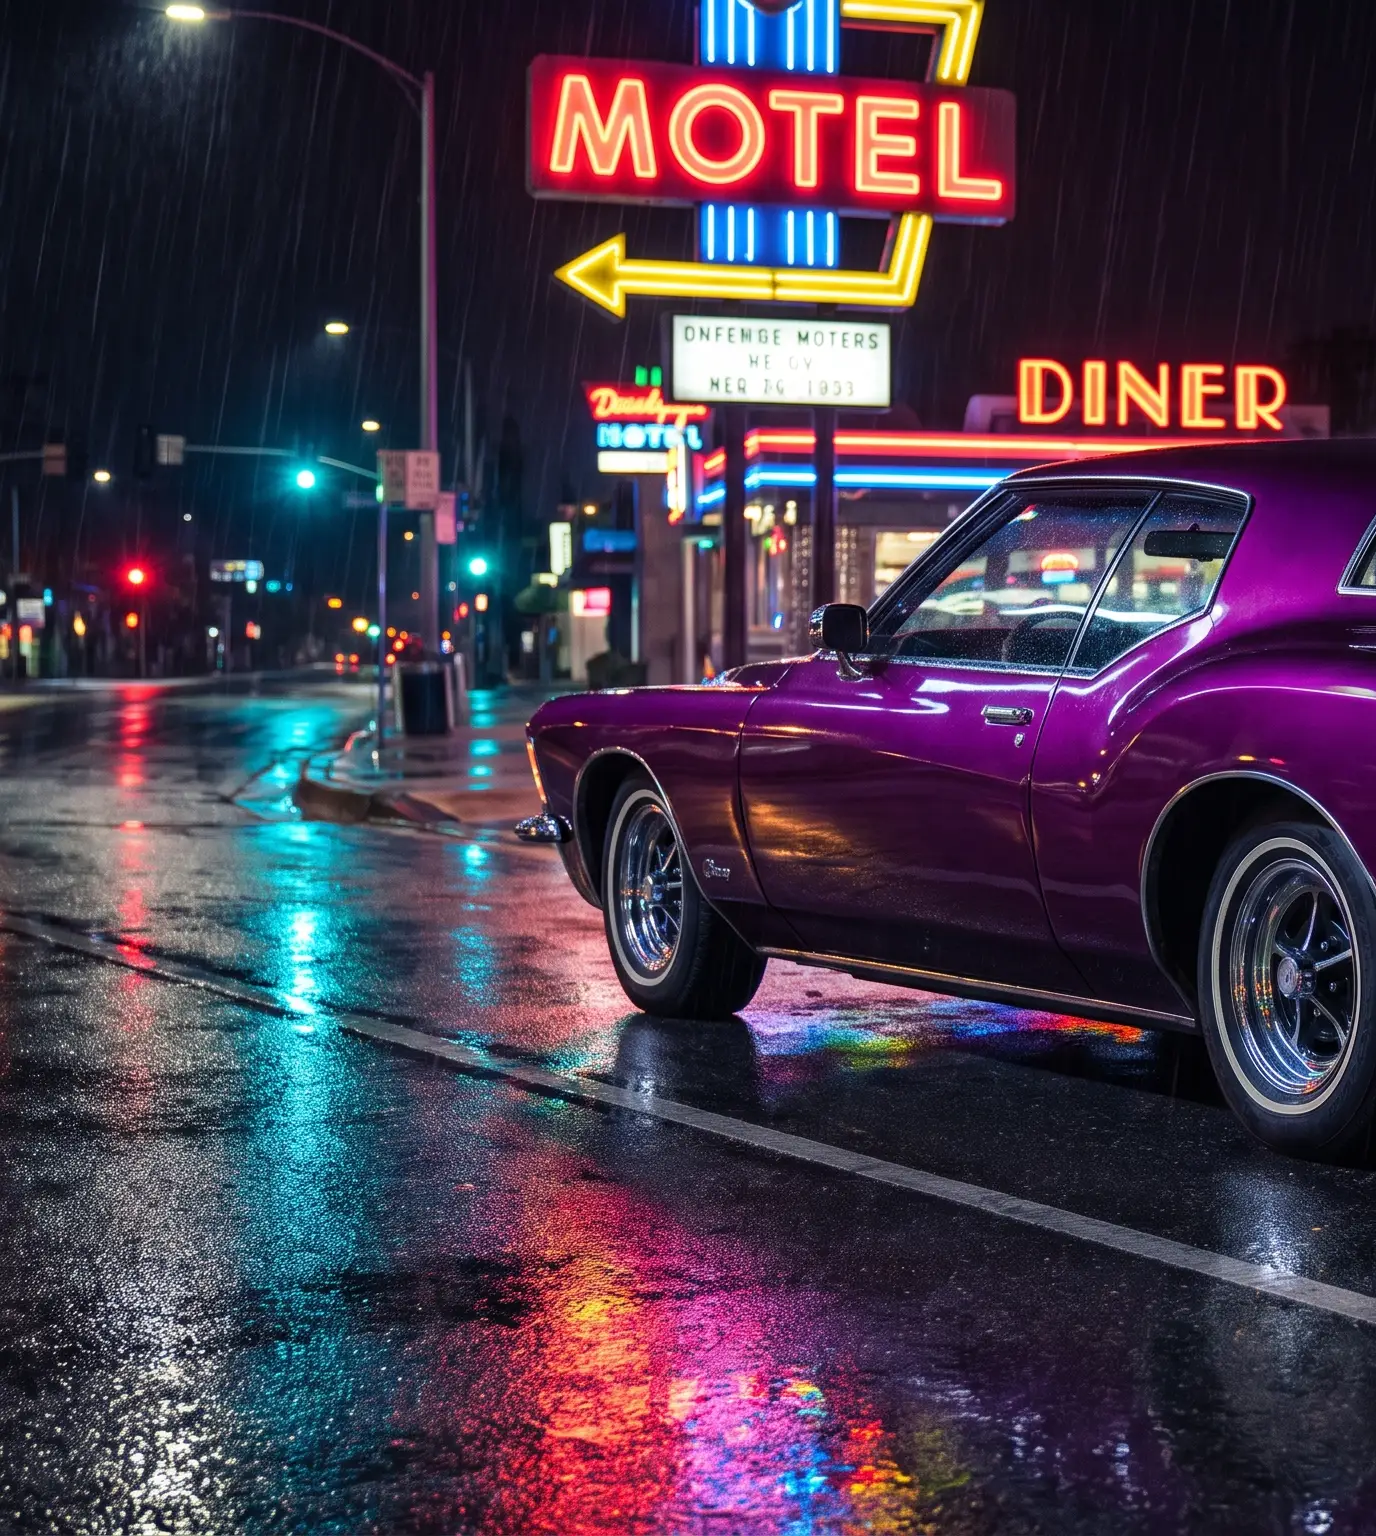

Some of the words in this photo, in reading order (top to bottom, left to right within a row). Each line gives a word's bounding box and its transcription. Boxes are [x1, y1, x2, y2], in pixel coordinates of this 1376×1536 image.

[549, 73, 1003, 201] MOTEL
[797, 330, 880, 350] MOTERS
[1019, 358, 1287, 430] DINER
